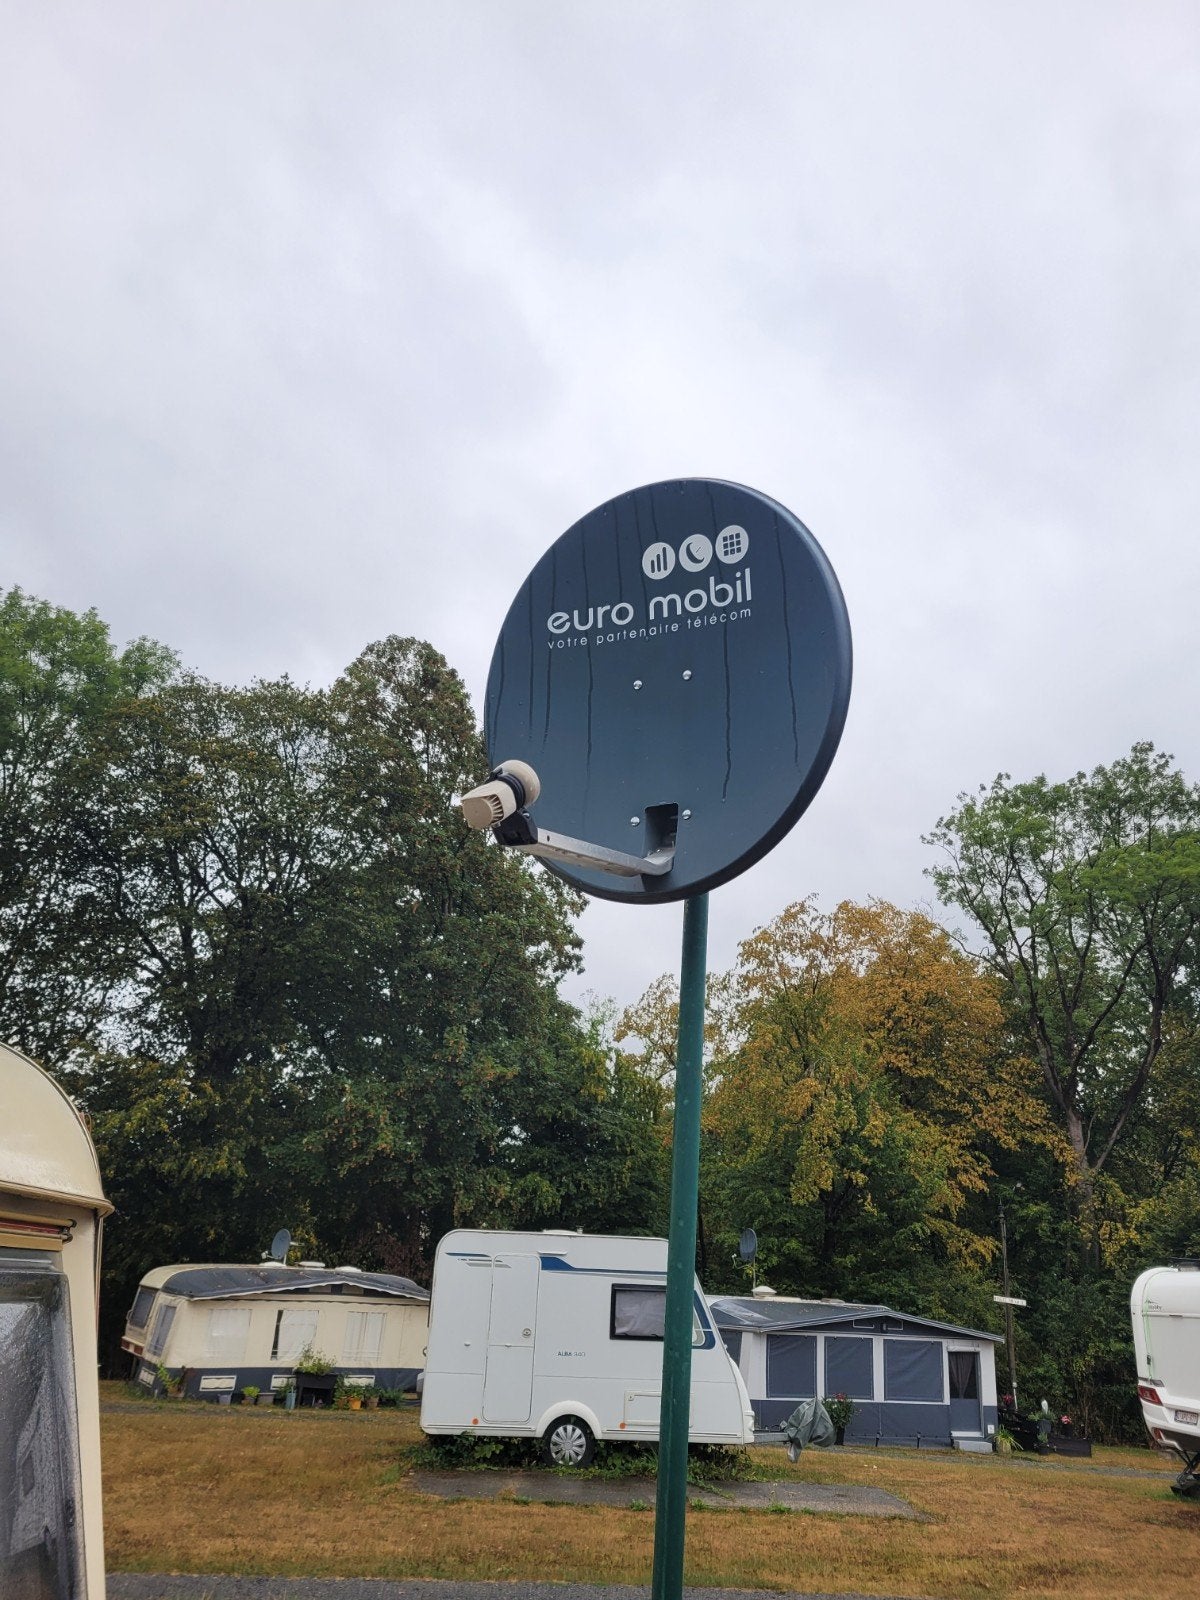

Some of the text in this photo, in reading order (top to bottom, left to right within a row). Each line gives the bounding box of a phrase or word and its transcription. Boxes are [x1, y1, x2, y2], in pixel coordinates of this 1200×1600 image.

[547, 567, 752, 634] euro mobil
[547, 607, 751, 649] votre partenaire télécom
